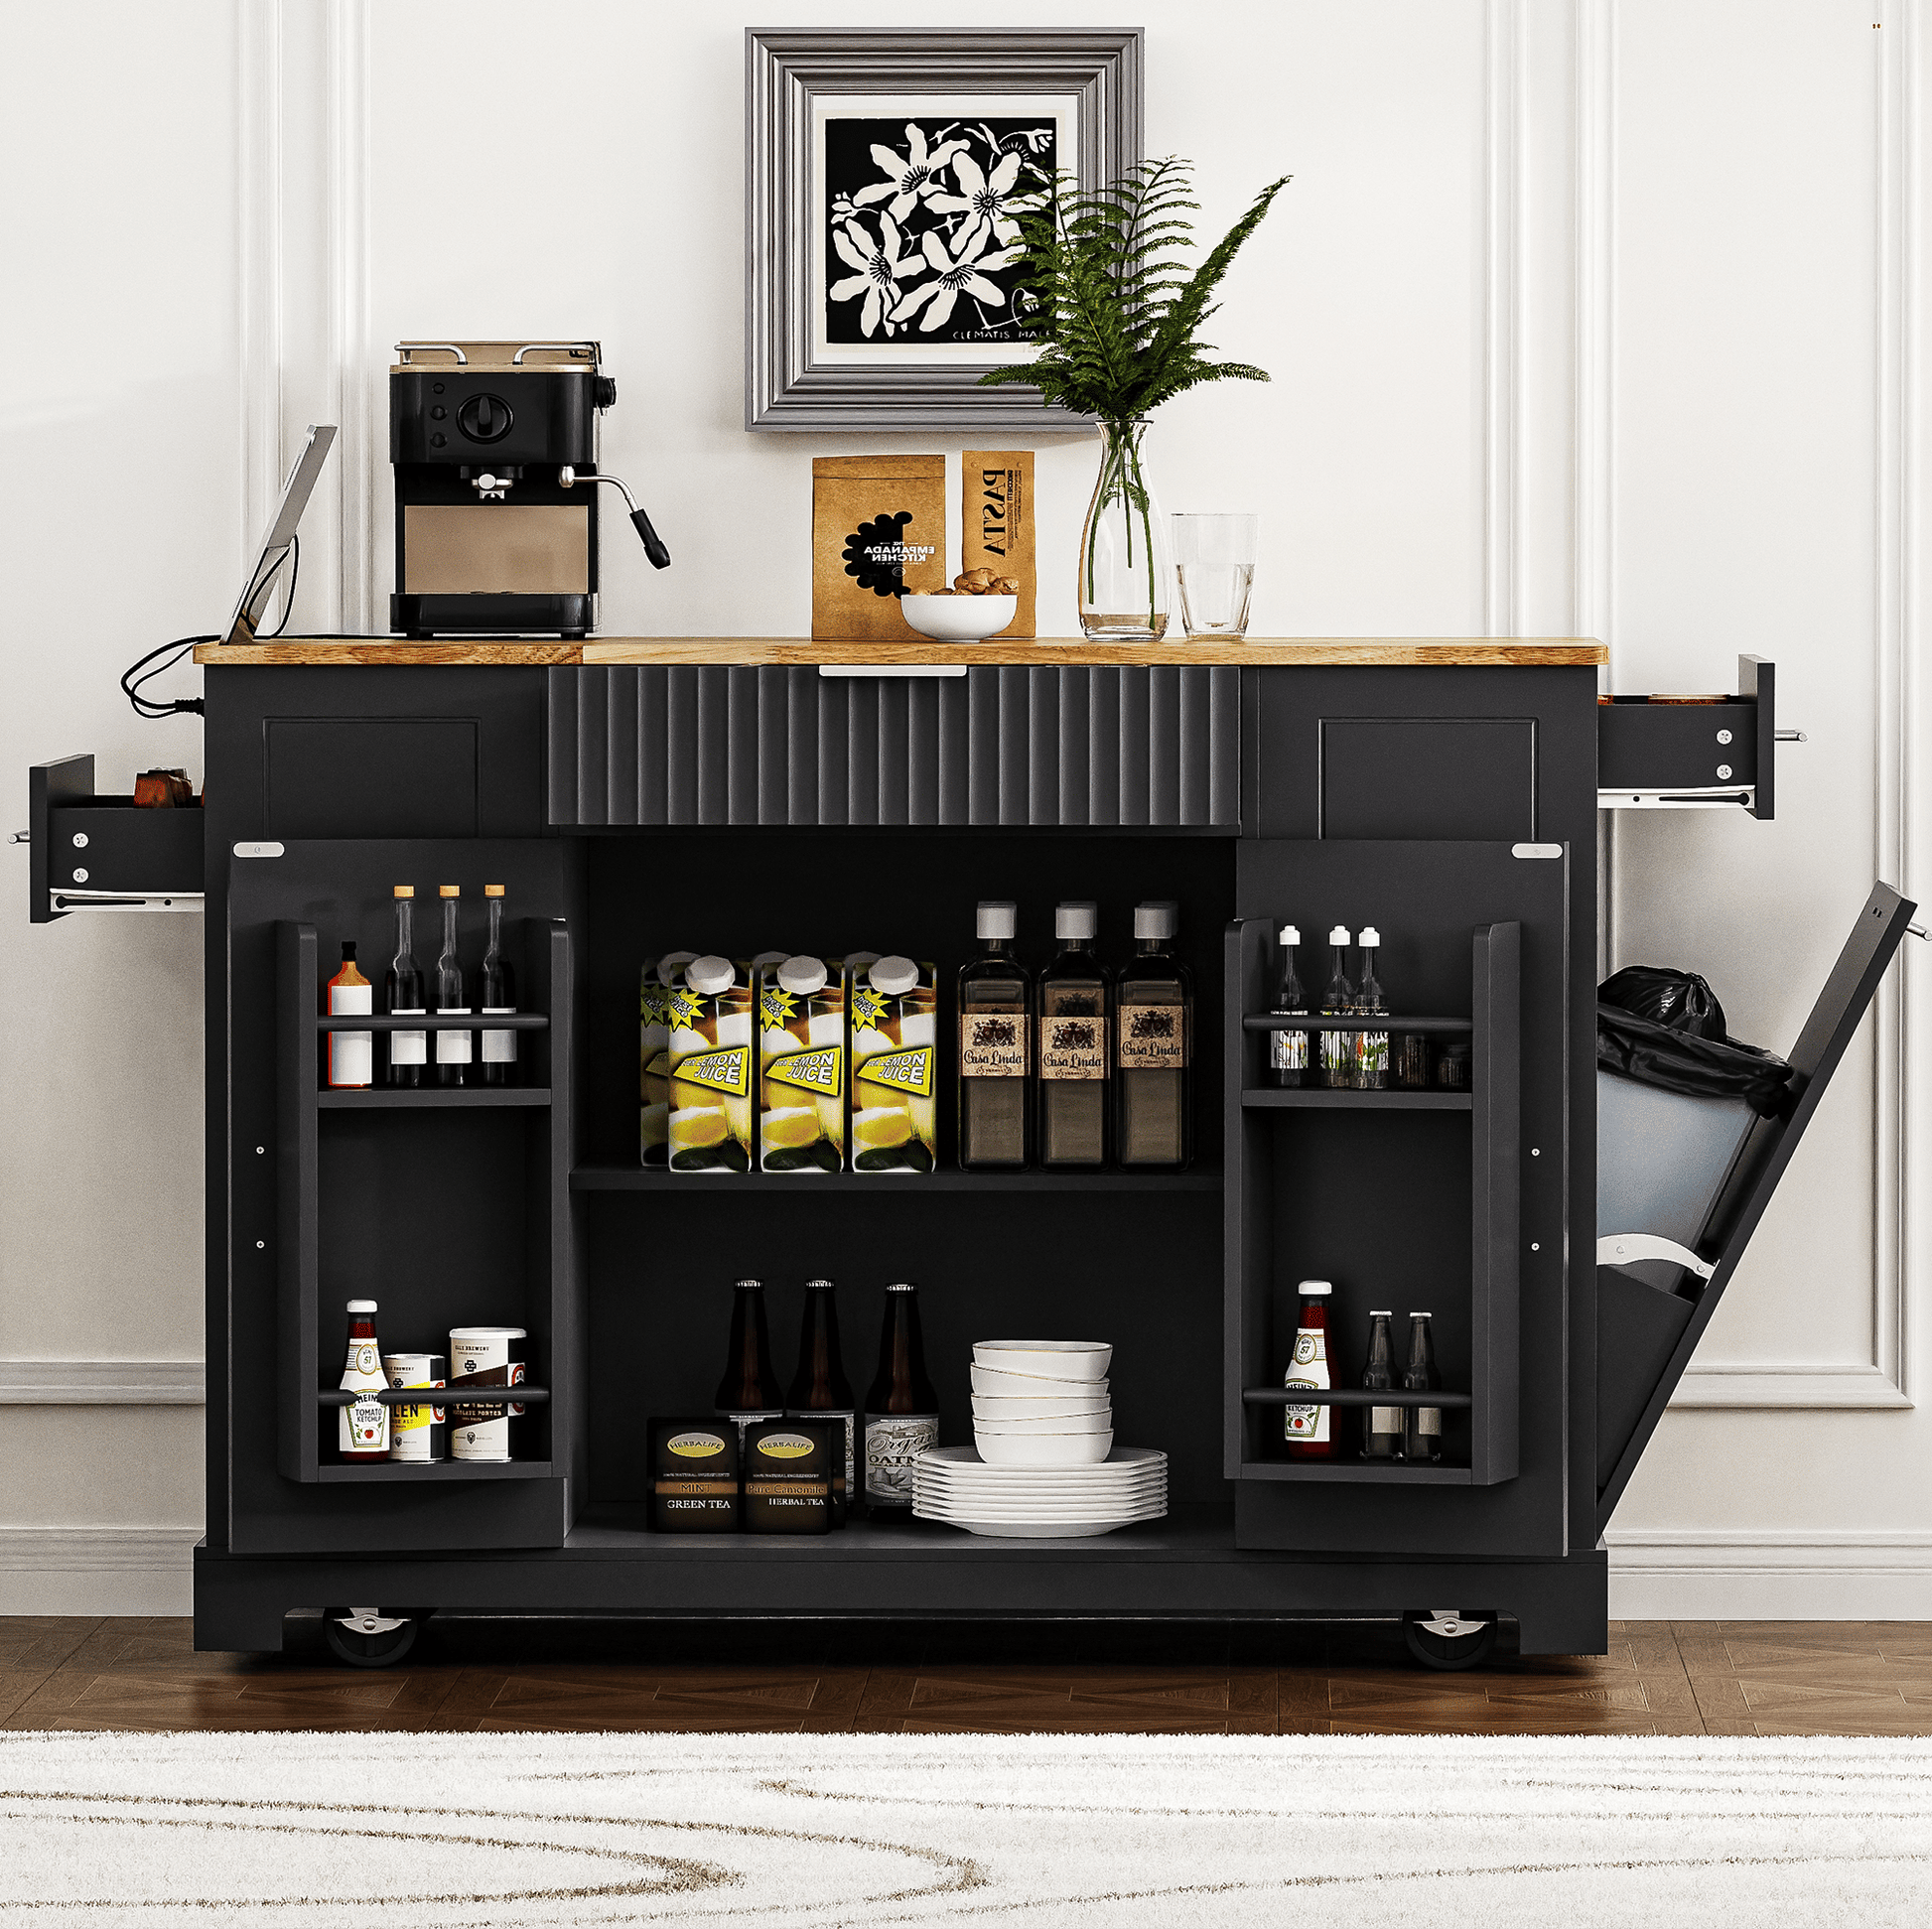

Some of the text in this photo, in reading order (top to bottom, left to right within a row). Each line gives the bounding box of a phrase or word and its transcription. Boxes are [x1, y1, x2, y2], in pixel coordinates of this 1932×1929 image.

[952, 330, 1011, 340] CLEMATIS
[1122, 1040, 1180, 1057] Casa Linda
[696, 1052, 743, 1066] LEMON
[788, 1052, 835, 1066] LEMON
[880, 1052, 926, 1066] LEMON
[963, 1049, 1023, 1065] Casa Linda
[1042, 1052, 1102, 1068] Casa Linda
[694, 1066, 741, 1085] JUICE
[786, 1066, 833, 1085] JUICE
[878, 1066, 924, 1085] JUICE
[1300, 1345, 1311, 1354] 57
[362, 1355, 372, 1364] 57
[357, 1393, 378, 1404] HEIN
[354, 1408, 383, 1417] TOMATO
[669, 1441, 723, 1450] HERBALIFE
[759, 1442, 812, 1450] HERBALIFE
[680, 1483, 713, 1493] MINT
[747, 1483, 825, 1494] Pure Camomile
[667, 1499, 732, 1509] GREEN TEA
[768, 1497, 806, 1506] HERBAL
